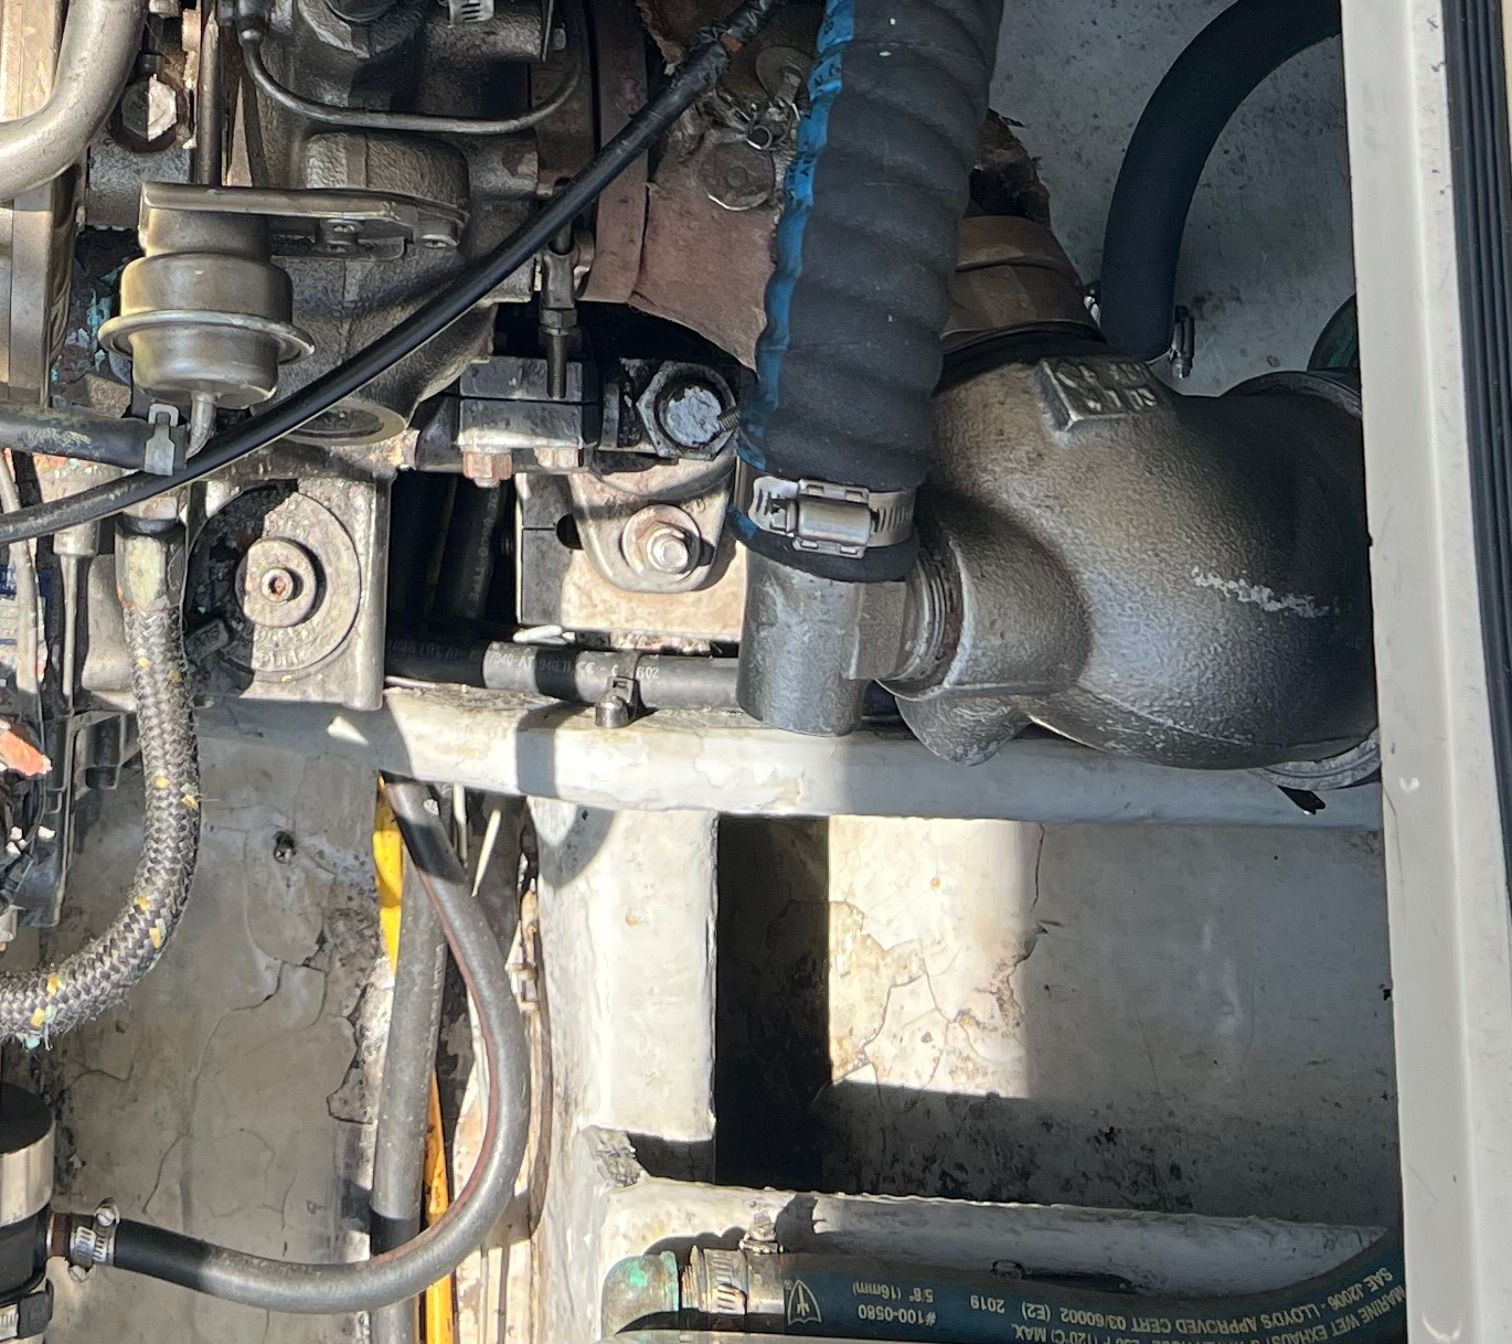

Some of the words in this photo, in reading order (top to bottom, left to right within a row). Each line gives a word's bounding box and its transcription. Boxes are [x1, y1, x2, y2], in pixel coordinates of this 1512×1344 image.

[852, 1282, 901, 1298] (16mm)
[1363, 1268, 1393, 1293] SAE
[970, 1295, 1005, 1313] 2019
[1327, 1283, 1364, 1312] J2006
[1358, 1285, 1405, 1323] MARINE
[858, 1304, 936, 1326] #100-0580
[1021, 1301, 1051, 1321] (E2)
[1060, 1307, 1126, 1330] 03/60002
[1260, 1303, 1317, 1329] LLOYD'S
[1011, 1323, 1046, 1341] MAX.
[1130, 1317, 1171, 1333] CERT
[1176, 1316, 1256, 1333] APPROVED
[1330, 1314, 1360, 1336] WET
